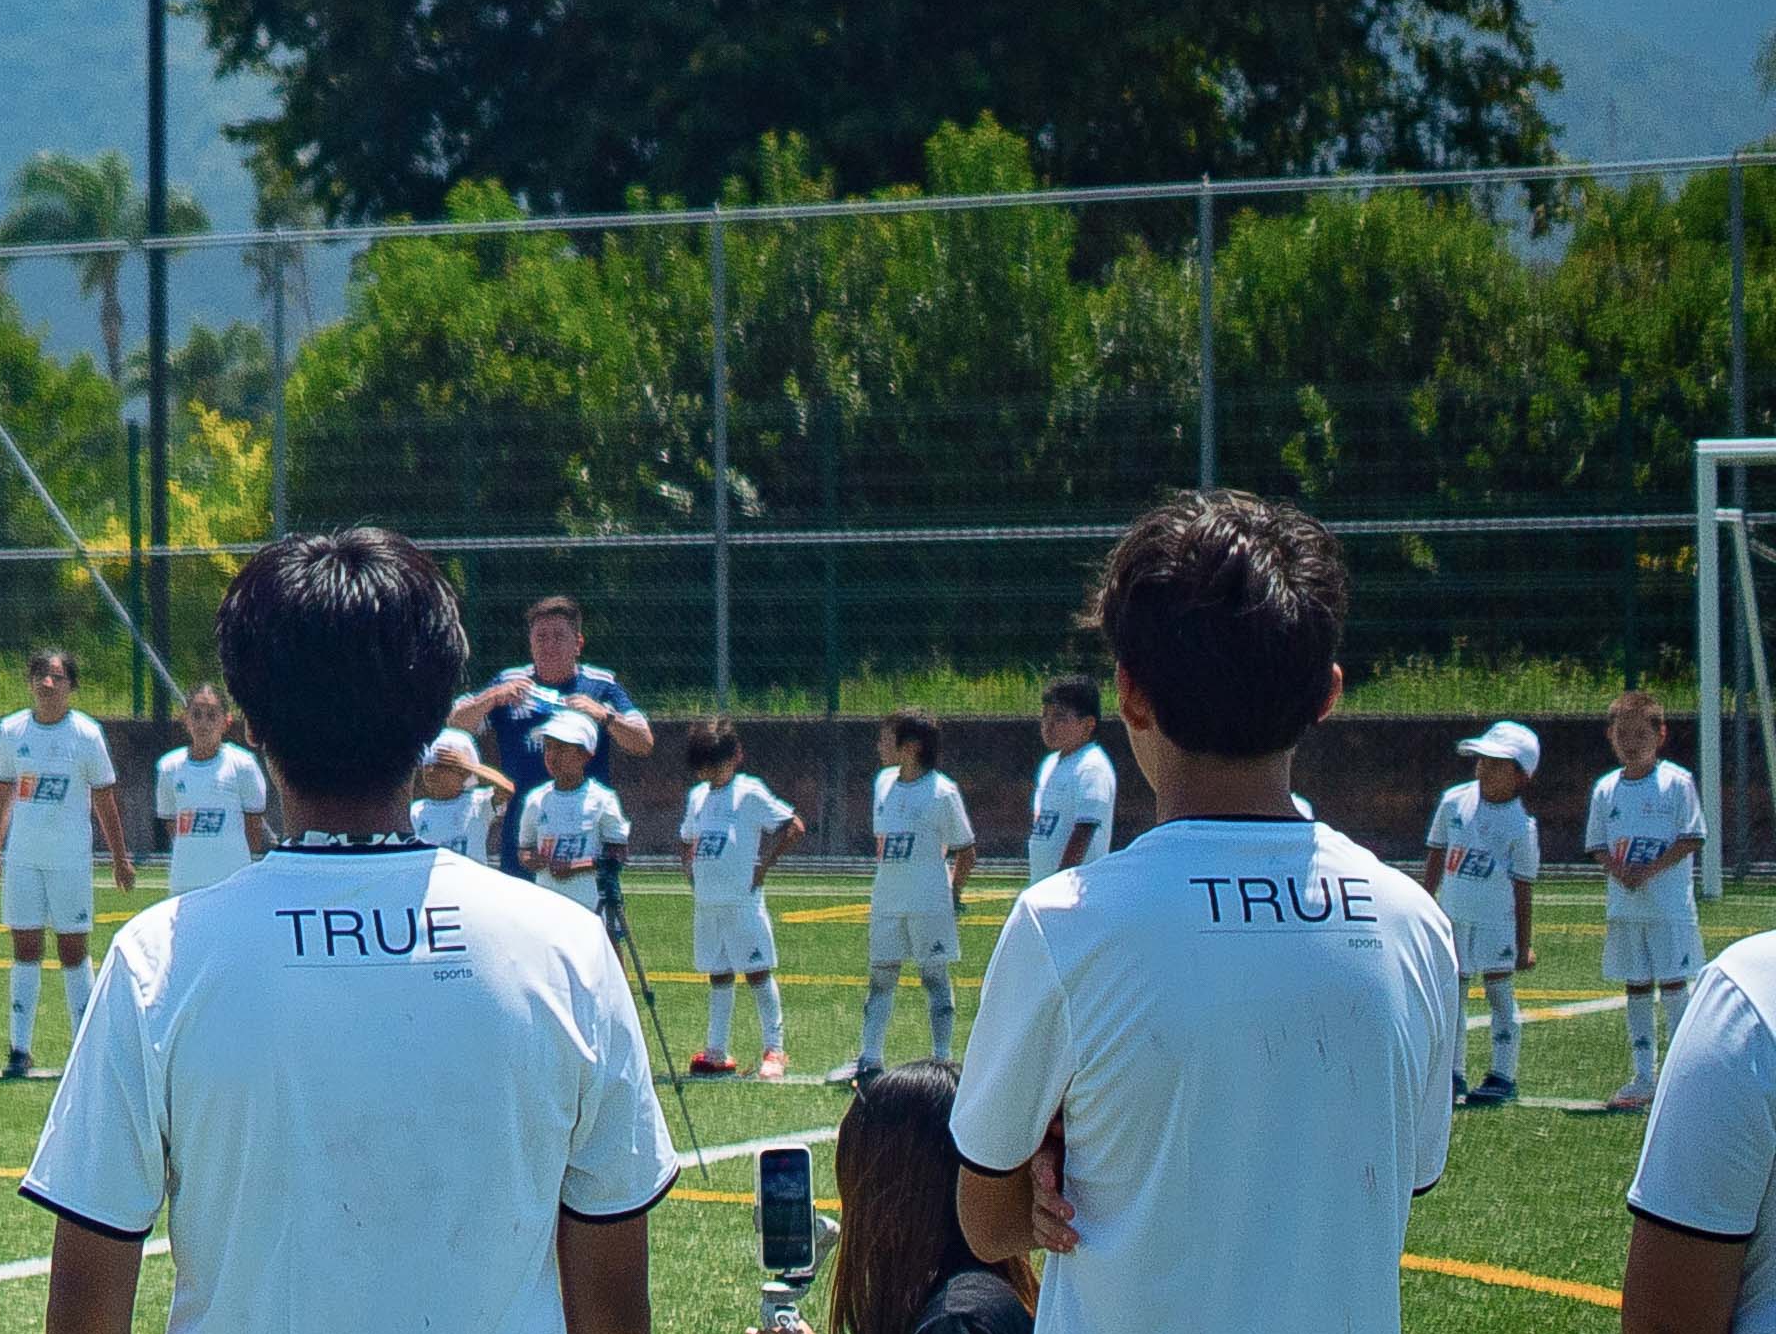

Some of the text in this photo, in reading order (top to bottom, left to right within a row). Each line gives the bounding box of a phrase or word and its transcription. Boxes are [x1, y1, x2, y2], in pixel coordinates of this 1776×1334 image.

[1189, 876, 1378, 923] TRUE
[275, 906, 467, 956] TRUE
[1348, 937, 1383, 949] sports
[433, 968, 473, 982] sports
